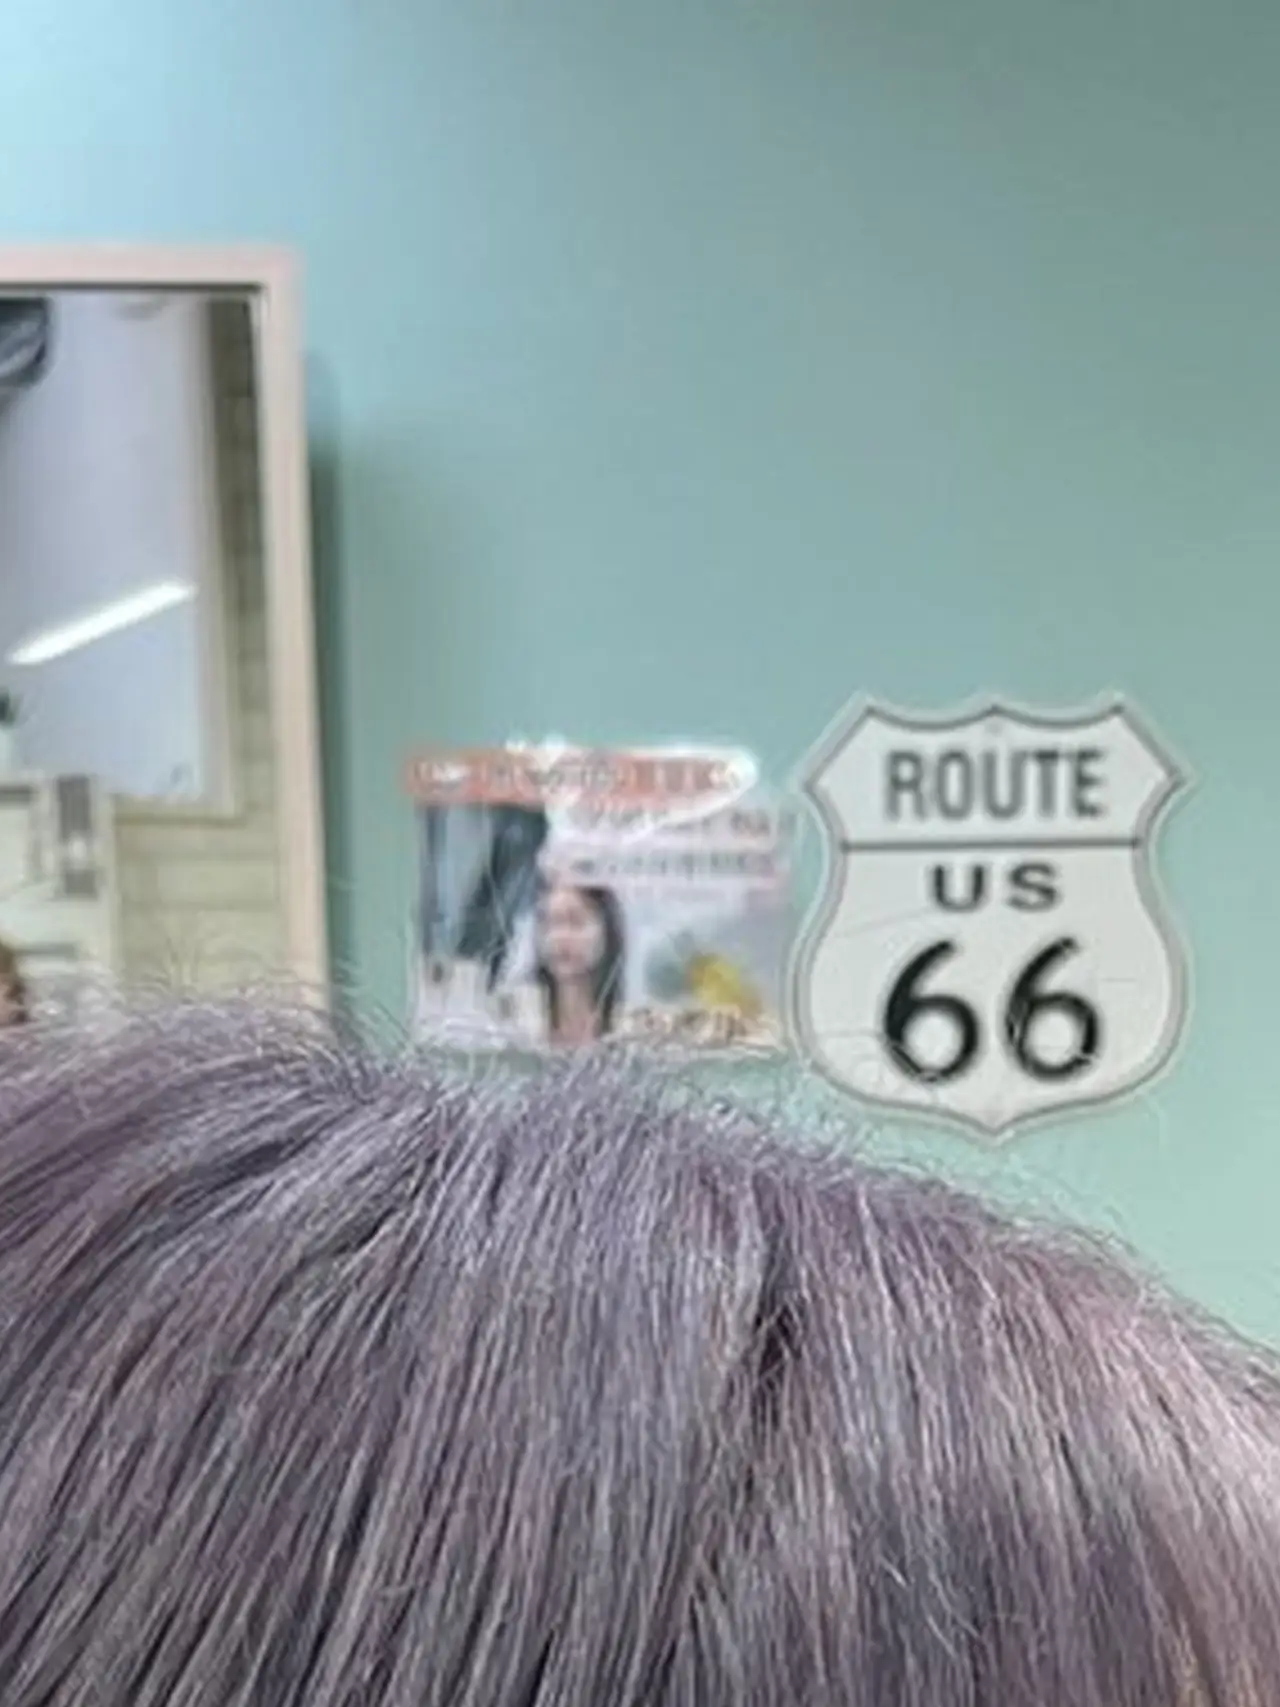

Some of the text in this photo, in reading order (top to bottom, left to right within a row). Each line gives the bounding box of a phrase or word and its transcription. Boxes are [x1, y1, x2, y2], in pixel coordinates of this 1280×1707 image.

[884, 749, 1107, 822] ROUTE
[930, 861, 1062, 913] US
[883, 937, 1099, 1082] 66
